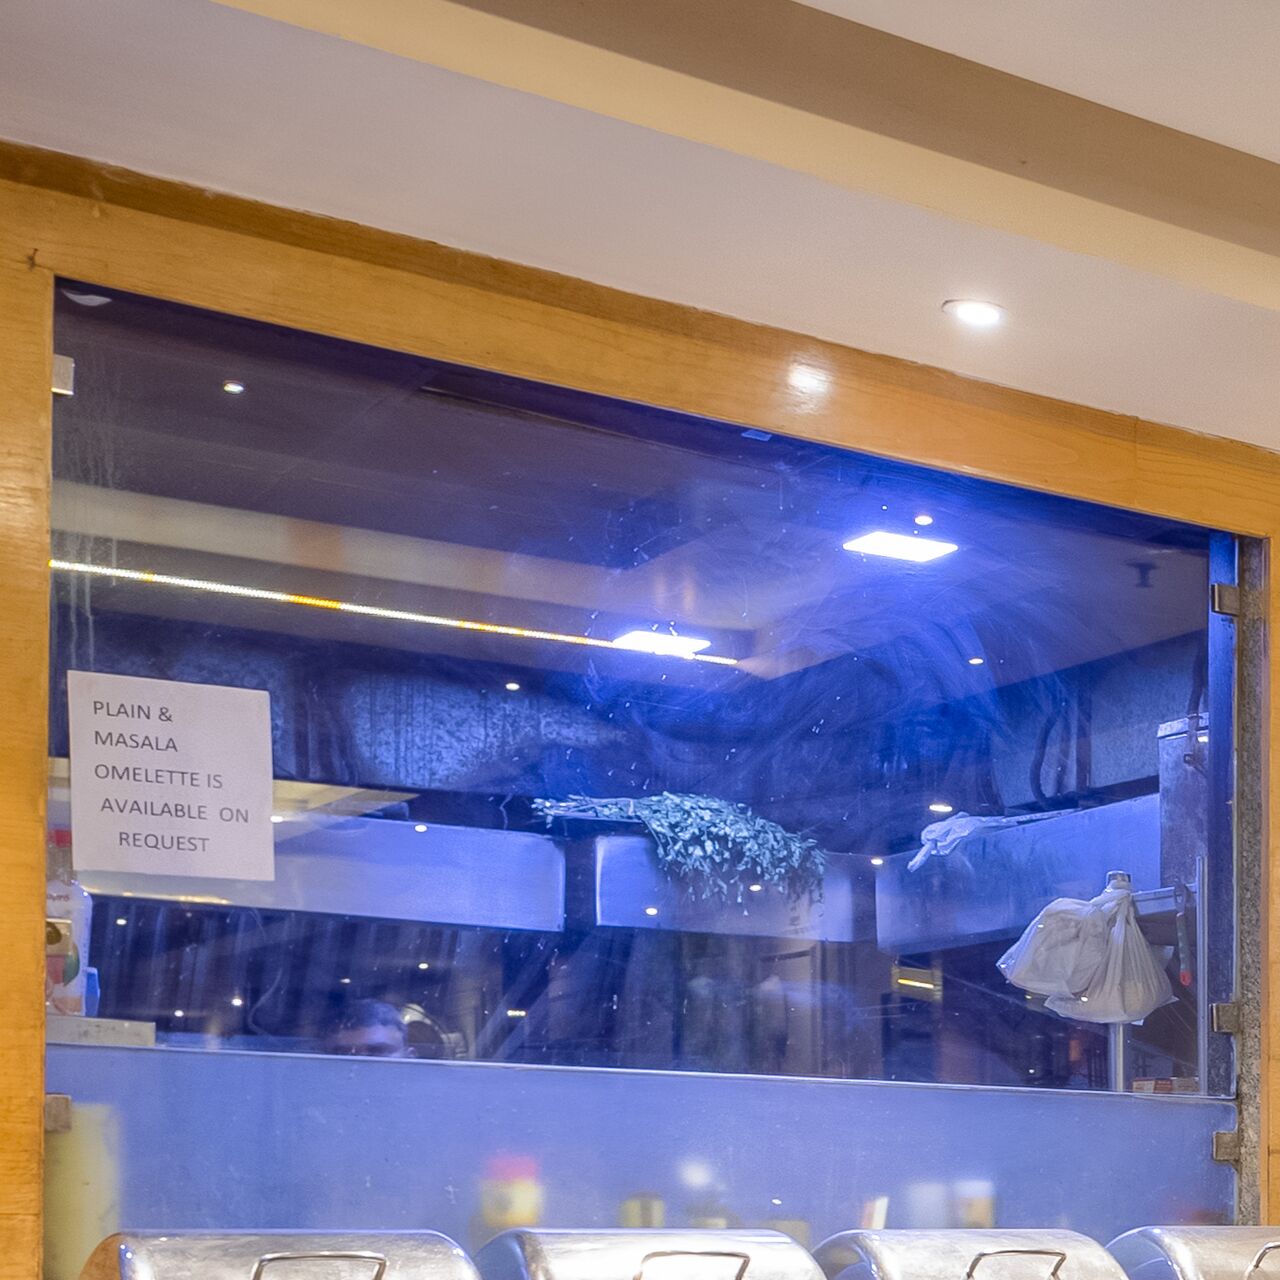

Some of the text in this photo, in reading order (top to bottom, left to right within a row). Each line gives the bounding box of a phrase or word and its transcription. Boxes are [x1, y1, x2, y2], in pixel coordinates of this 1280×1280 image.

[93, 701, 173, 723] PLAIN &
[94, 730, 178, 752] MASALA
[94, 763, 223, 789] OMELETTE IS
[100, 797, 249, 823] AVAILABLE ON
[119, 831, 210, 852] REQUEST
